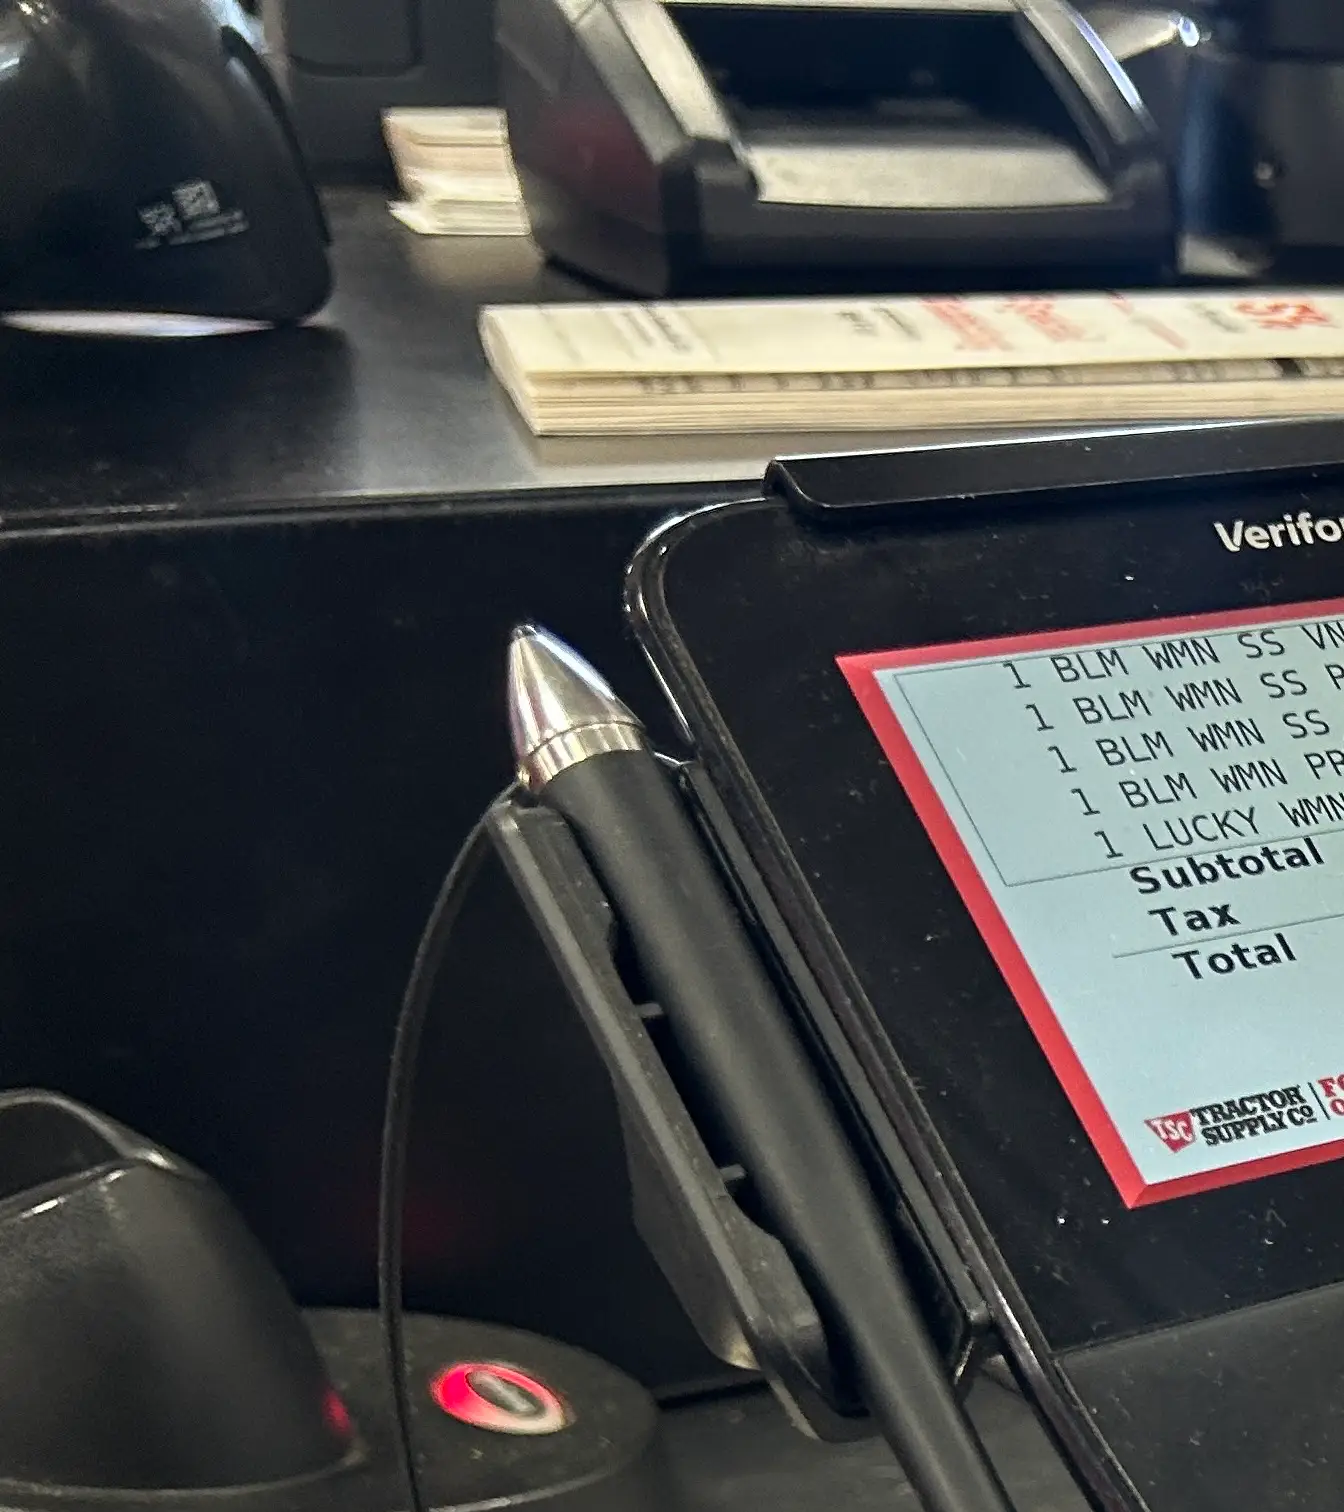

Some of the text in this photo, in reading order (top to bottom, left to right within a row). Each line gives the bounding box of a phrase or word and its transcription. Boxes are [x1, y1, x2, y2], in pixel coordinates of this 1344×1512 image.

[1002, 661, 1031, 689] 1
[1051, 647, 1129, 686] BLM
[1142, 637, 1220, 674] WMN
[1237, 630, 1285, 659] SS
[1024, 703, 1054, 732] 1
[1072, 689, 1152, 726] BLM
[1164, 678, 1244, 713] WMN
[1259, 670, 1308, 700] SS
[1047, 745, 1077, 774] 1
[1095, 730, 1174, 767] BLM
[1186, 718, 1266, 754] WMN
[1282, 709, 1330, 740] SS
[1070, 787, 1100, 817] 1
[1118, 771, 1198, 809] BLM
[1210, 758, 1289, 795] WMN
[1093, 830, 1123, 860] 1
[1142, 806, 1260, 851] LUCKY
[1129, 836, 1325, 895] Subtotal
[1147, 903, 1241, 936] Tax
[1171, 932, 1297, 980] Total
[1152, 1118, 1191, 1143] TSC
[1189, 1085, 1308, 1126] TRACTOR
